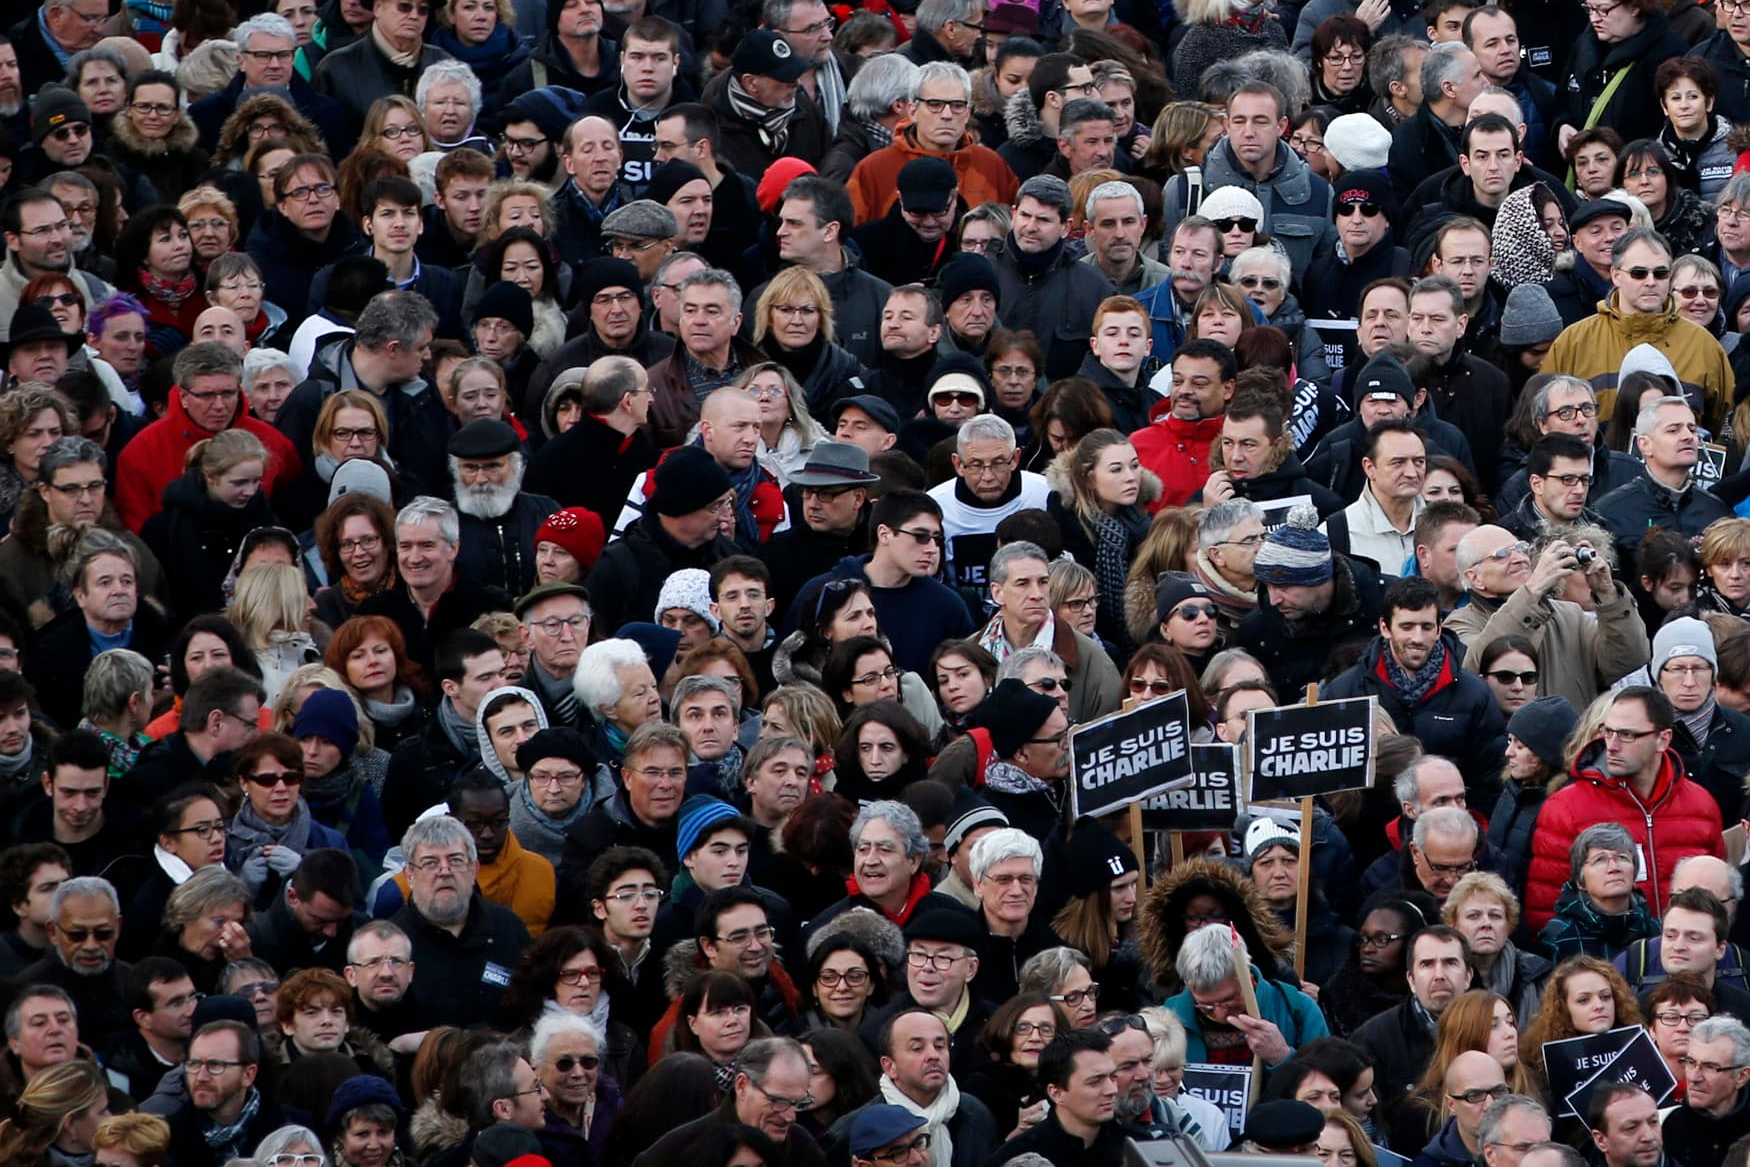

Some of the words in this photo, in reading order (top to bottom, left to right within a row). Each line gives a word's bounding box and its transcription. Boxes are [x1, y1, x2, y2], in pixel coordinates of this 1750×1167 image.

[1325, 354, 1345, 368] RLIE
[959, 565, 987, 584] JE
[1080, 744, 1115, 770] JE
[1118, 719, 1185, 760] SUIS
[1260, 735, 1296, 755] JE
[1299, 726, 1366, 750] SUIS
[1080, 735, 1189, 791] CHARLIE
[1259, 744, 1366, 778] CHARLIE
[483, 969, 510, 986] CHARLI
[1576, 1057, 1590, 1070] JE
